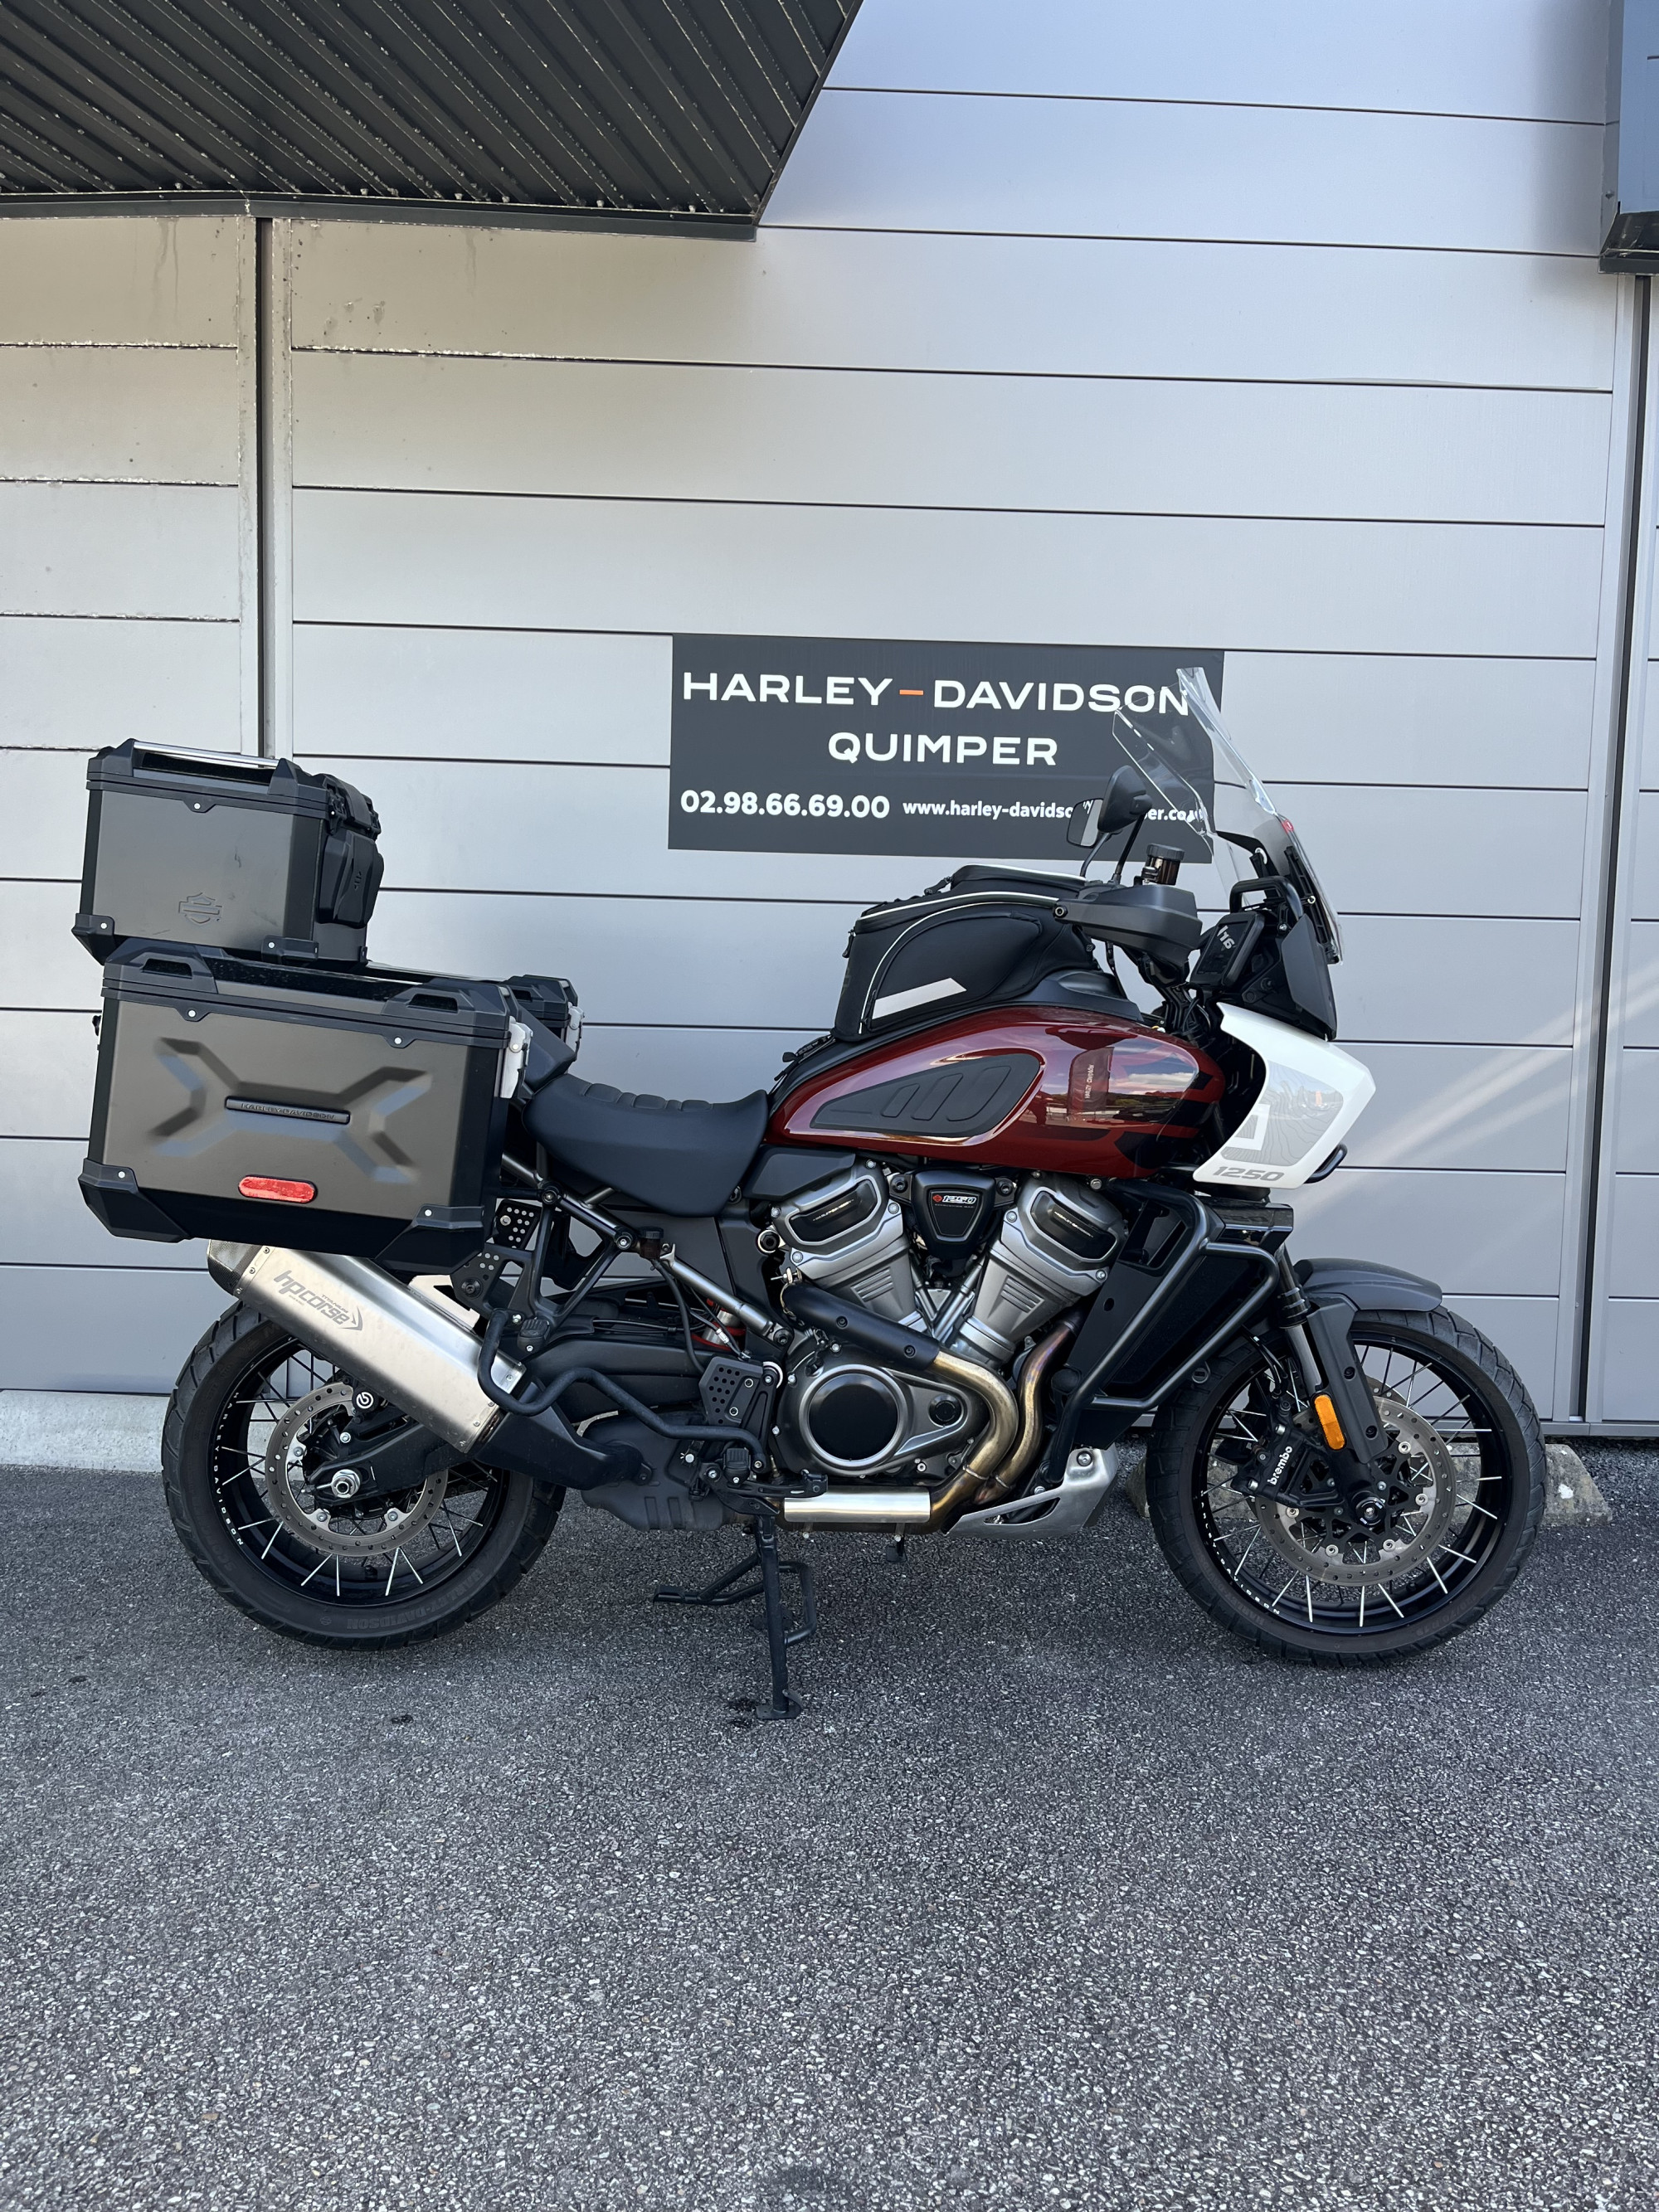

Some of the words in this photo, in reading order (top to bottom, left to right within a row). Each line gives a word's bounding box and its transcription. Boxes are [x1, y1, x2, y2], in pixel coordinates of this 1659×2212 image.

[828, 732, 1058, 767] QUIMPER
[680, 790, 890, 819] 02.98.66.69.00
[241, 1103, 334, 1121] HARLEY-DAVIDSON
[1213, 1166, 1285, 1181] 1250
[942, 1194, 977, 1204] 1250
[274, 1270, 350, 1325] hpcorse
[1267, 1446, 1293, 1485] brembo
